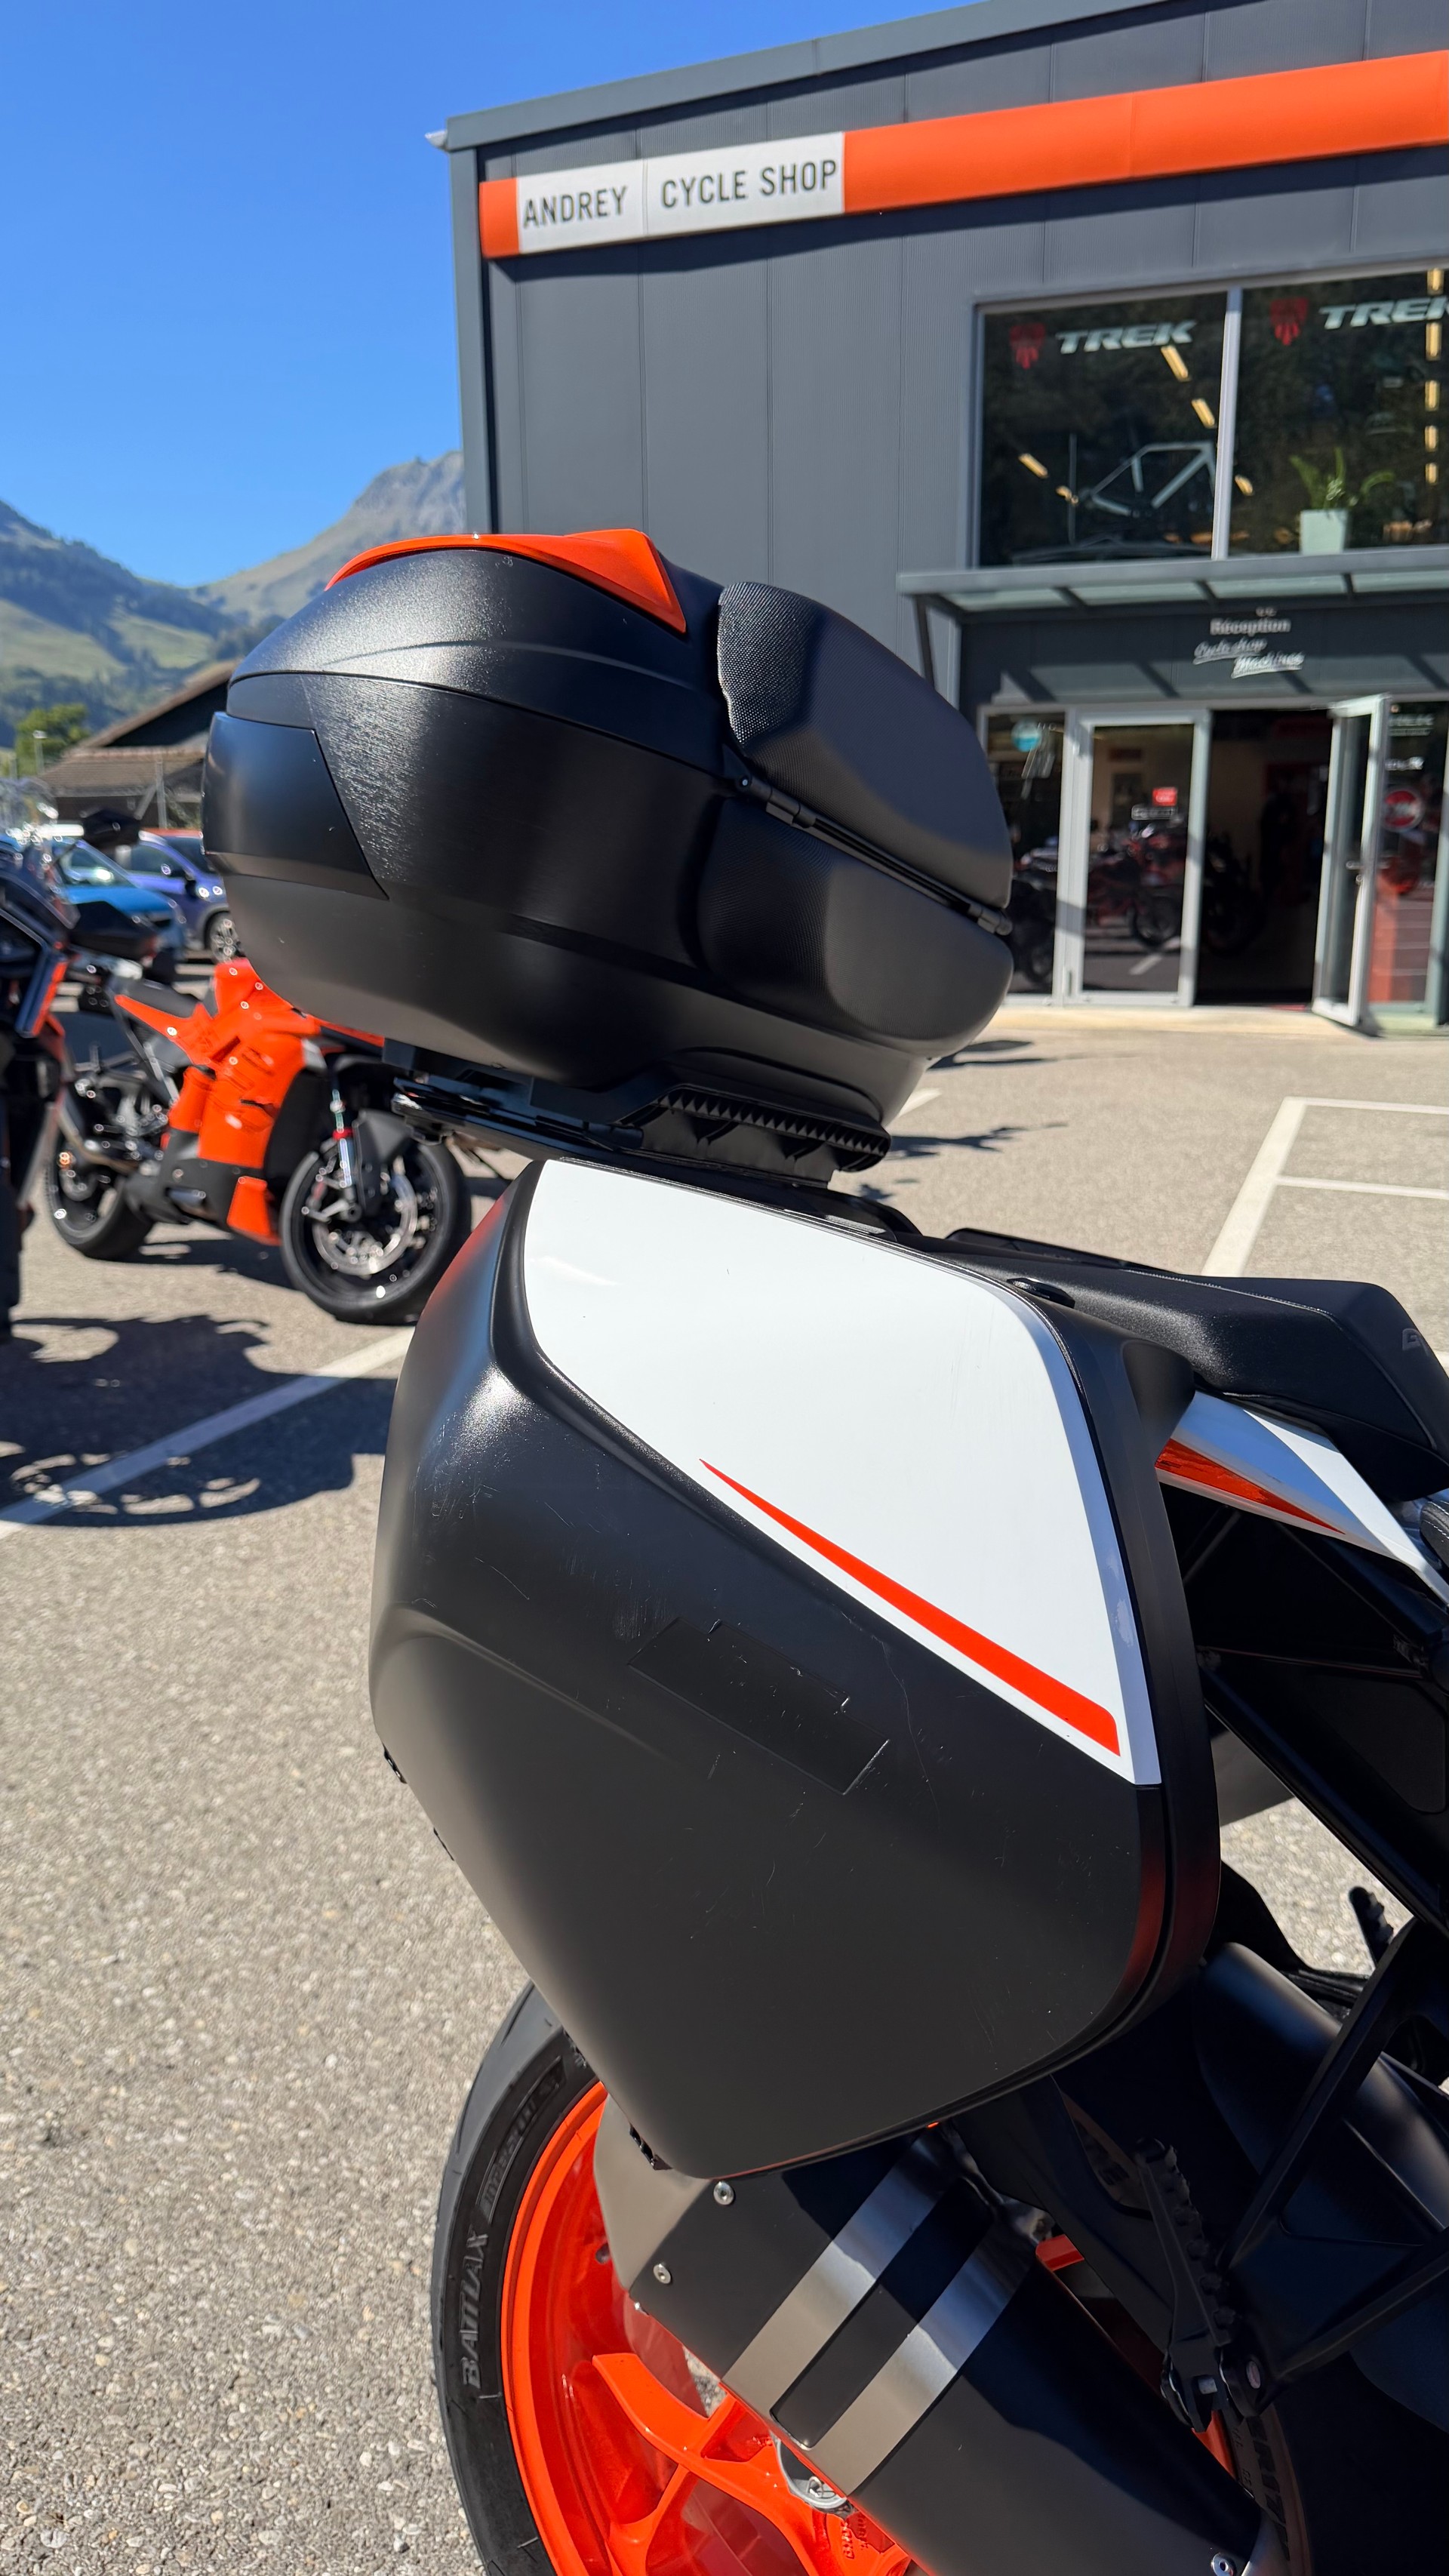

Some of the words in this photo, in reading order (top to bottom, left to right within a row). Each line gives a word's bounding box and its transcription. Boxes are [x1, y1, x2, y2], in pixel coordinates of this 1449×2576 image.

[523, 186, 628, 229] ANDREY
[662, 170, 747, 208] CYCLE
[760, 159, 838, 195] SHOP
[1055, 319, 1197, 354] TREK
[460, 2224, 488, 2389] BATTLAX
